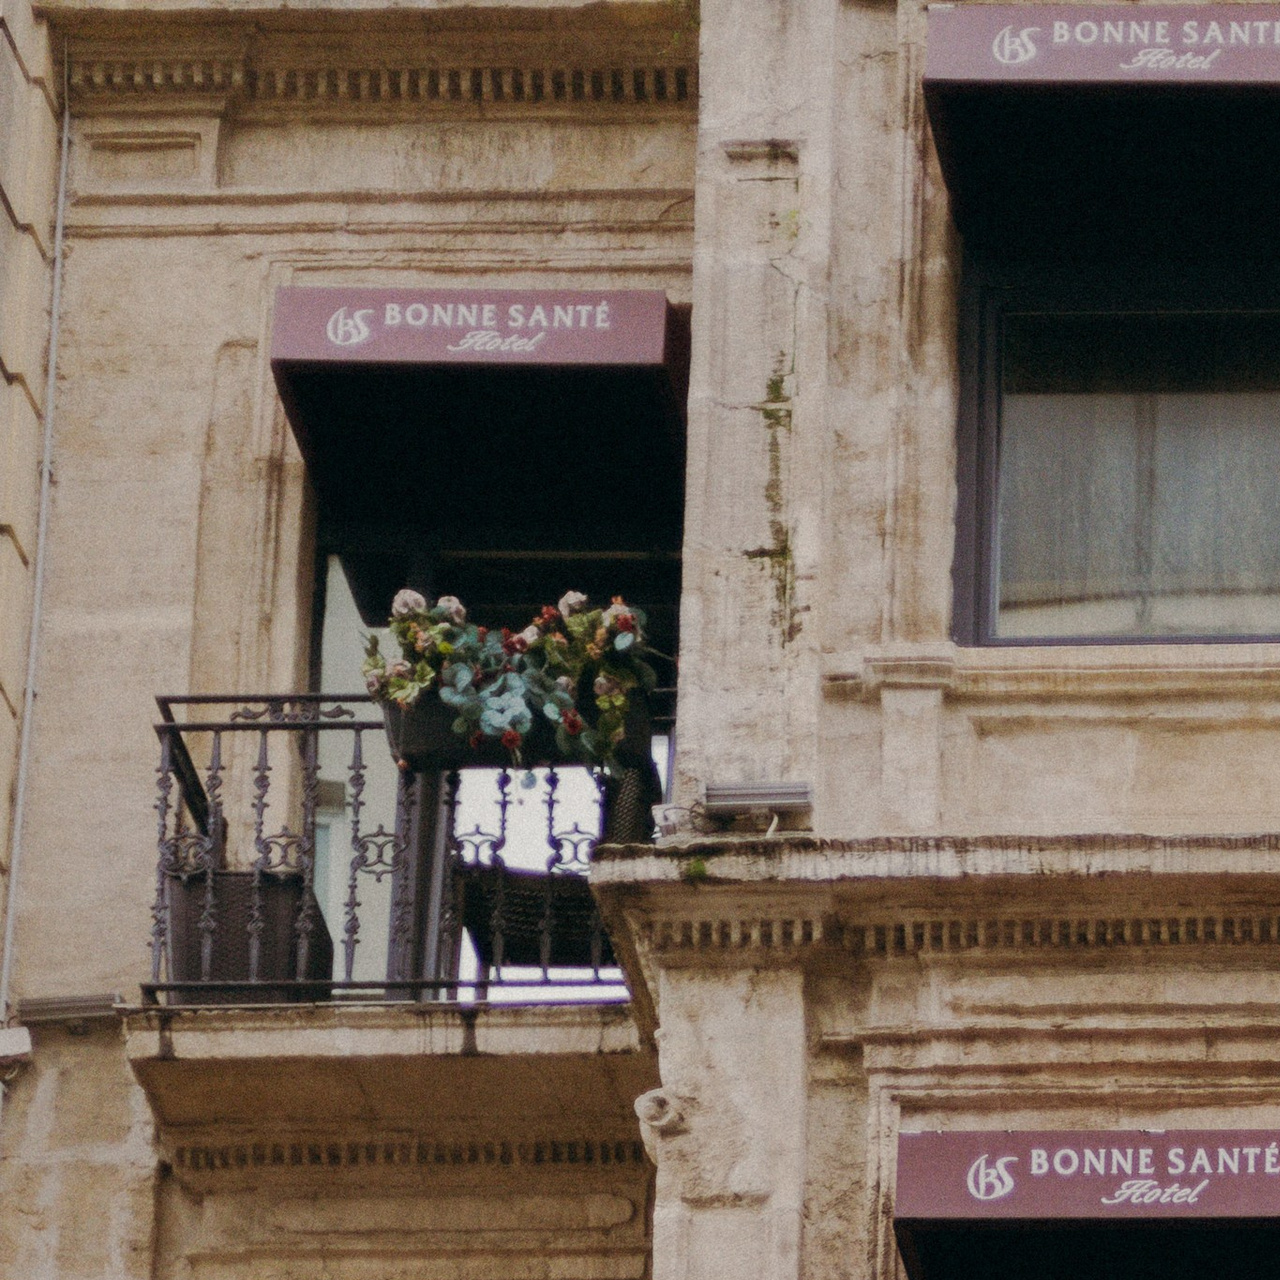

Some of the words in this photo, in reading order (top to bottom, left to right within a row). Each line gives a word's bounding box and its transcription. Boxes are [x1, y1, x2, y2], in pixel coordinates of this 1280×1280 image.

[1052, 21, 1171, 44] BONNE
[1119, 48, 1221, 70] Hotel
[384, 303, 497, 327] BONNE
[507, 298, 610, 328] SANTÉ
[447, 330, 544, 352] Hotel
[1029, 1147, 1156, 1177] BONNE
[1100, 1178, 1210, 1206] Hotel
